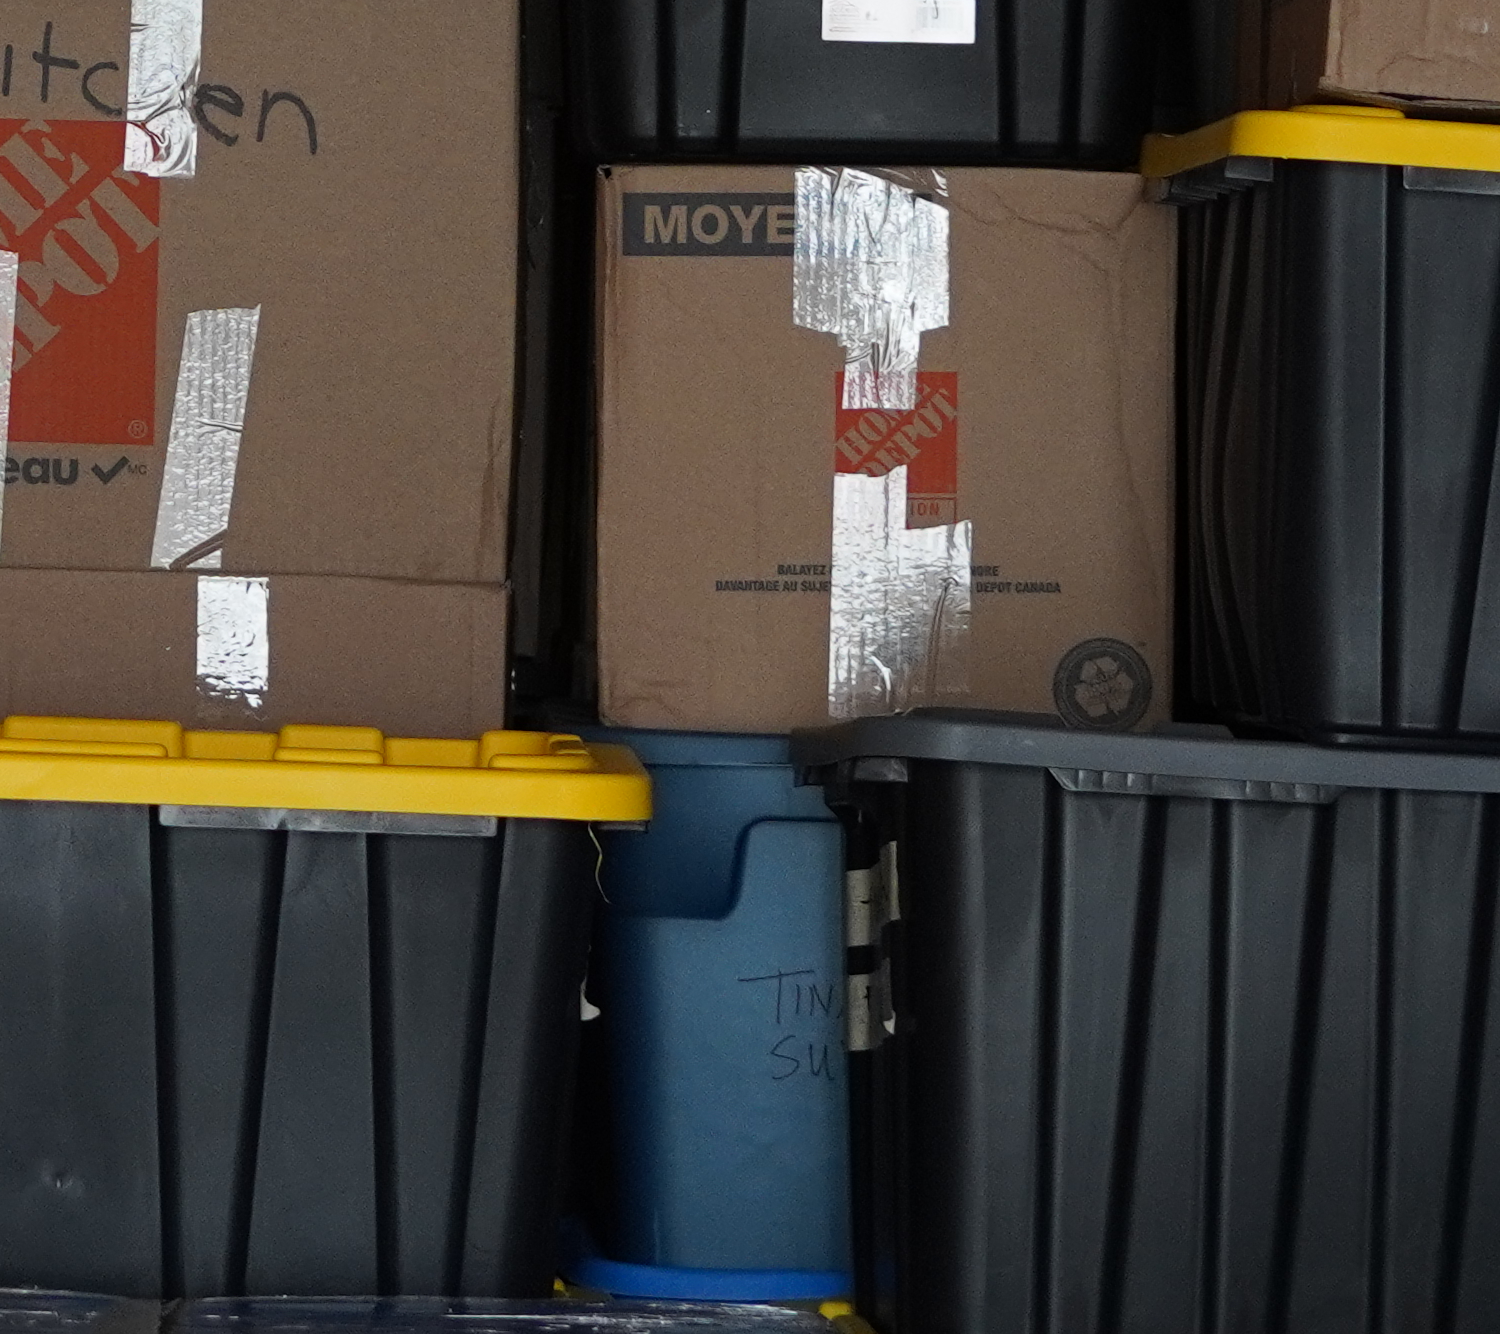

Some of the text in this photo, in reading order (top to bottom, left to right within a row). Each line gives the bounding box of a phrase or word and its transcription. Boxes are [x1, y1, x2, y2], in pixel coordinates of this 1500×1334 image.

[5, 455, 79, 486] eau
[777, 564, 826, 576] BALAYEZ
[715, 580, 1062, 594] DAVANTAGE AU SUJE DEPOT CANADA
[737, 969, 843, 1025] TIN
